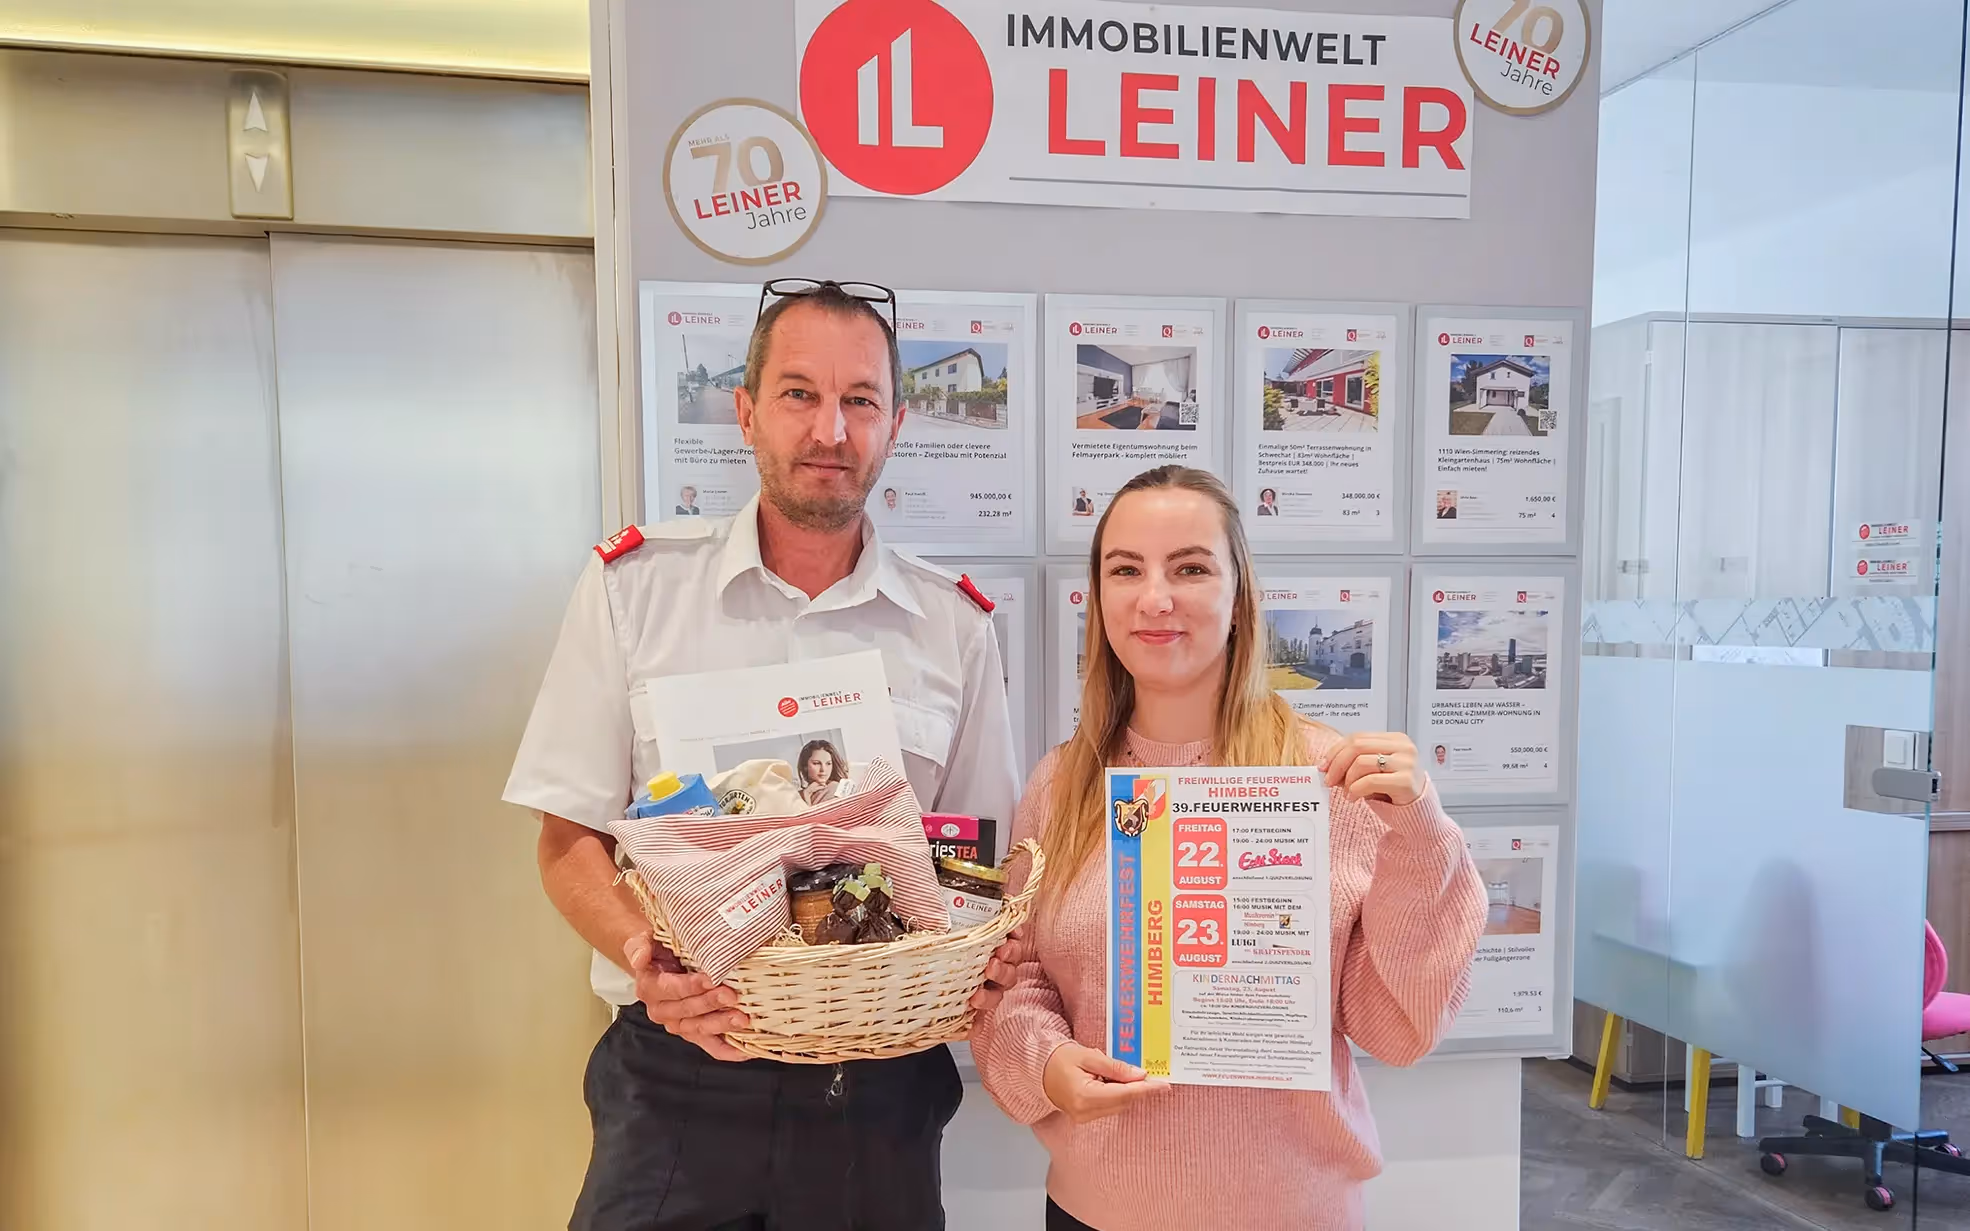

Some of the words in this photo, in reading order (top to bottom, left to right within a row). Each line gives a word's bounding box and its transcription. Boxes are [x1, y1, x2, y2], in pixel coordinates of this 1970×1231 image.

[1006, 13, 1387, 66] IMMOBILIENWELT
[1470, 23, 1561, 80] LEINER
[1500, 60, 1553, 96] Jahre
[1047, 68, 1468, 171] LEINER
[688, 137, 712, 147] MEHR
[715, 134, 730, 142] ALS
[690, 136, 784, 195] 70
[693, 181, 802, 219] LEINER
[745, 206, 807, 230] Jahre
[685, 316, 720, 324] LEINER
[1112, 443, 1179, 451] Eigentumswohnung
[1258, 444, 1289, 452] Einmalige
[689, 456, 708, 464] Büro
[720, 457, 747, 465] mieten
[924, 451, 959, 459] Ziegelbau
[1258, 460, 1287, 468] Bestpreis
[978, 510, 1001, 518] 232,28
[1878, 525, 1909, 535] LEINER
[1877, 563, 1908, 571] LEINER
[813, 693, 861, 707] LEINER
[1178, 776, 1244, 785] FREIWILLIGE
[1246, 776, 1312, 784] FEUERWEHR
[1208, 786, 1280, 798] HIMBERG
[1172, 801, 1320, 813] 39.FEUERWEHRFEST
[1178, 824, 1222, 833] FREITAG
[1177, 841, 1224, 868] 22.
[1179, 876, 1222, 885] AUGUST
[741, 879, 783, 914] LEINER
[966, 902, 992, 913] LEINER
[1175, 900, 1225, 909] SAMSTAG
[1176, 918, 1224, 945] 23.
[1231, 939, 1256, 947] LUIGI
[1119, 853, 1135, 1053] FEUERWEHRFEST
[1147, 899, 1163, 1006] HIMBERG
[1178, 954, 1222, 963] AUGUST
[1192, 974, 1301, 985] KINDERNACHMITTAG
